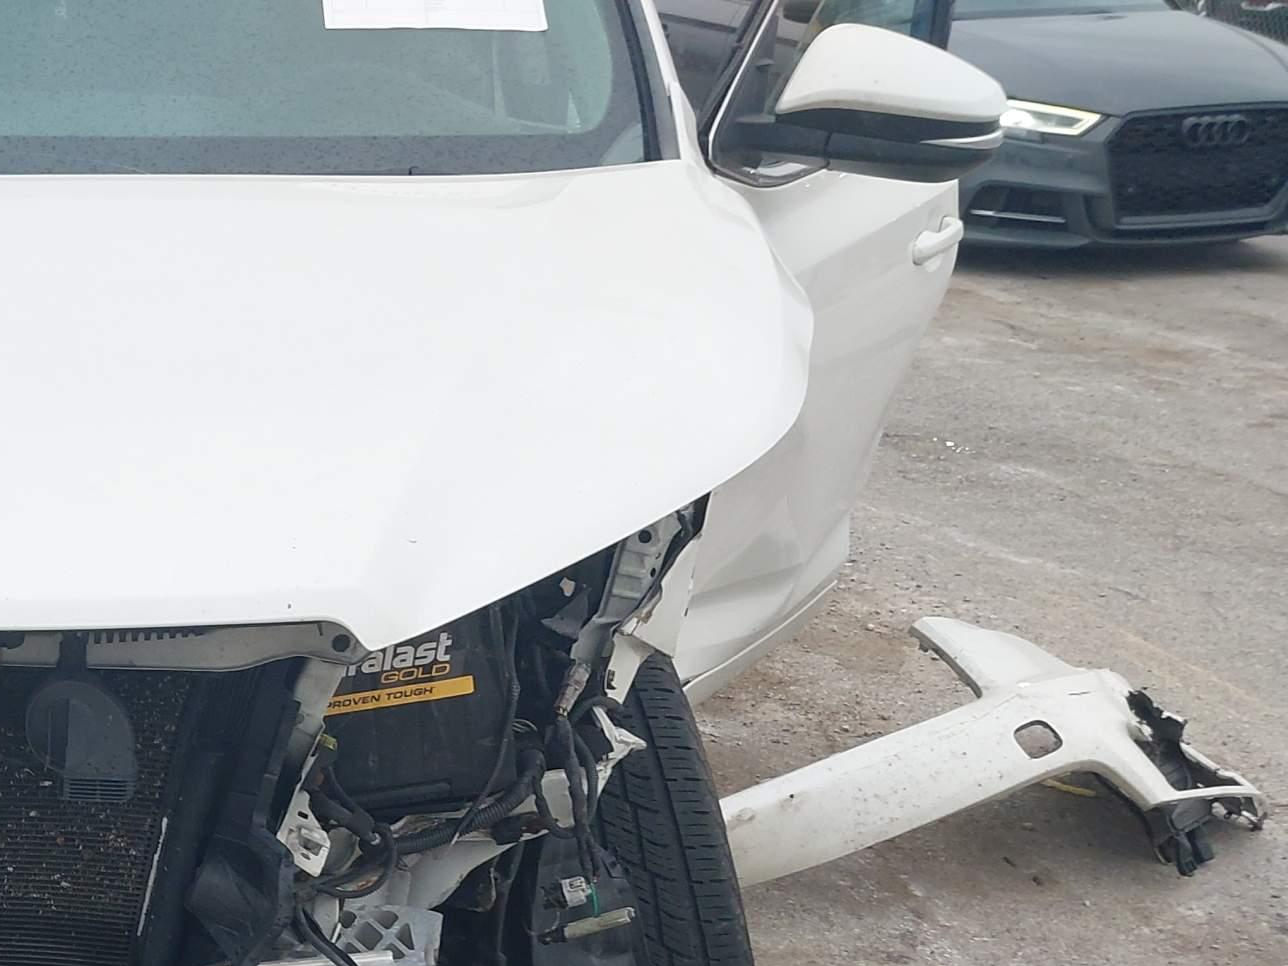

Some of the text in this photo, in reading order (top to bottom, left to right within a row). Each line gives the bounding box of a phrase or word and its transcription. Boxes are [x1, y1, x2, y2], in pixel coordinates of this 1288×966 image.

[343, 632, 452, 677] ralast
[380, 663, 451, 684] GOLD
[386, 686, 434, 700] TOUGH
